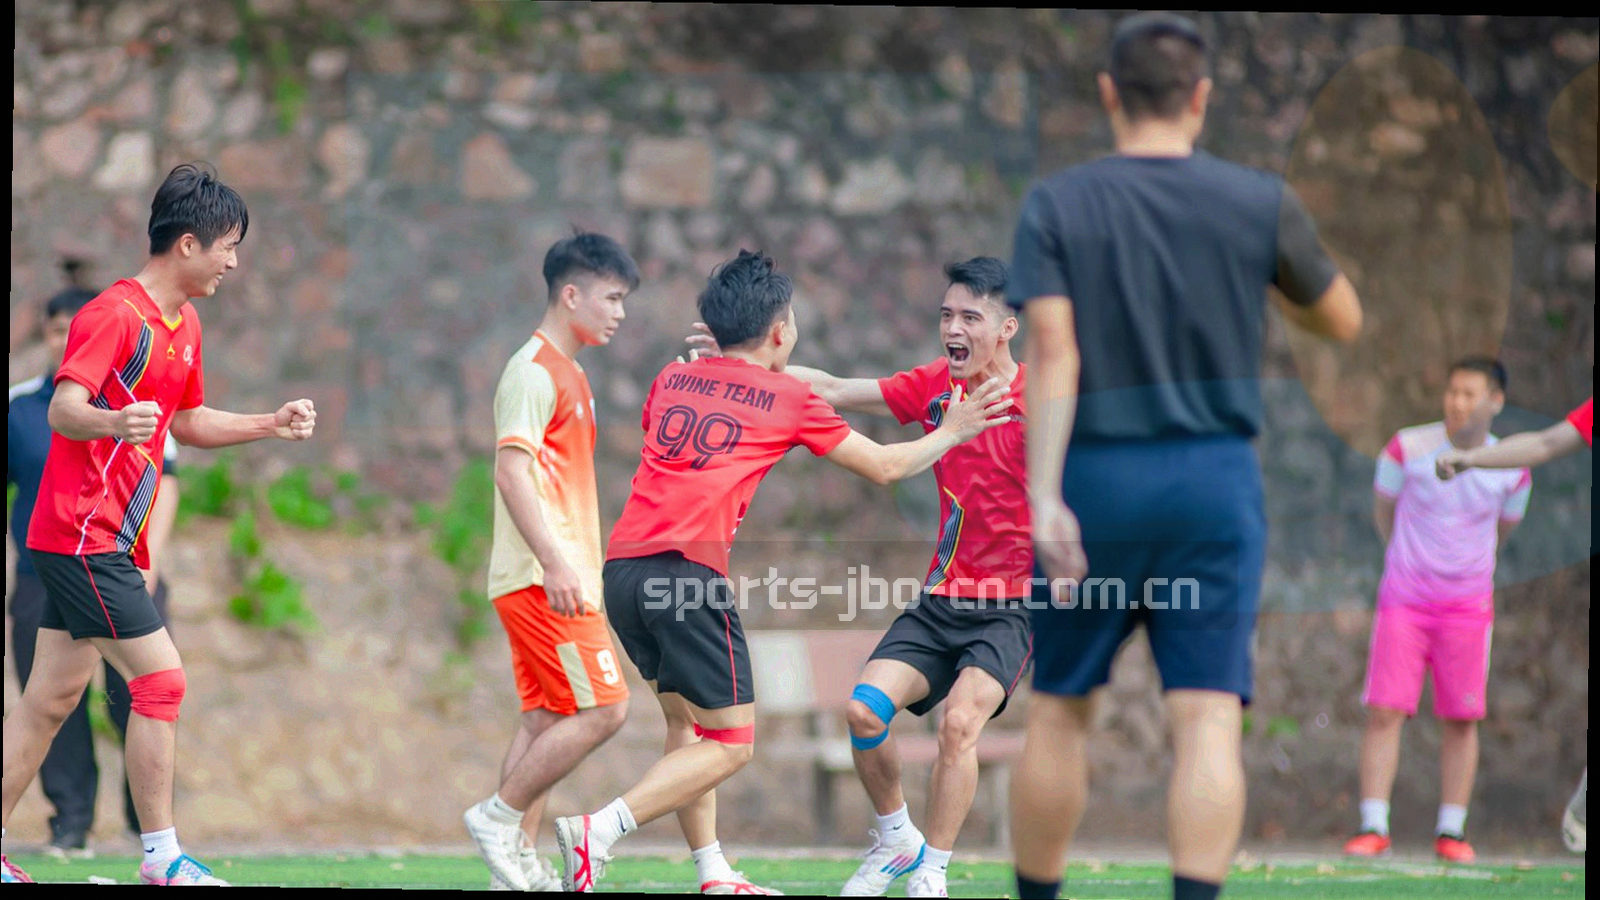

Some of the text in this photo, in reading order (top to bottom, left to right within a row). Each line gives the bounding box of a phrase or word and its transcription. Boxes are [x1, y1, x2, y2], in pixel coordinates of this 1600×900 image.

[664, 373, 776, 412] SWINE TEAM
[655, 404, 743, 470] 99
[596, 649, 619, 685] 9
